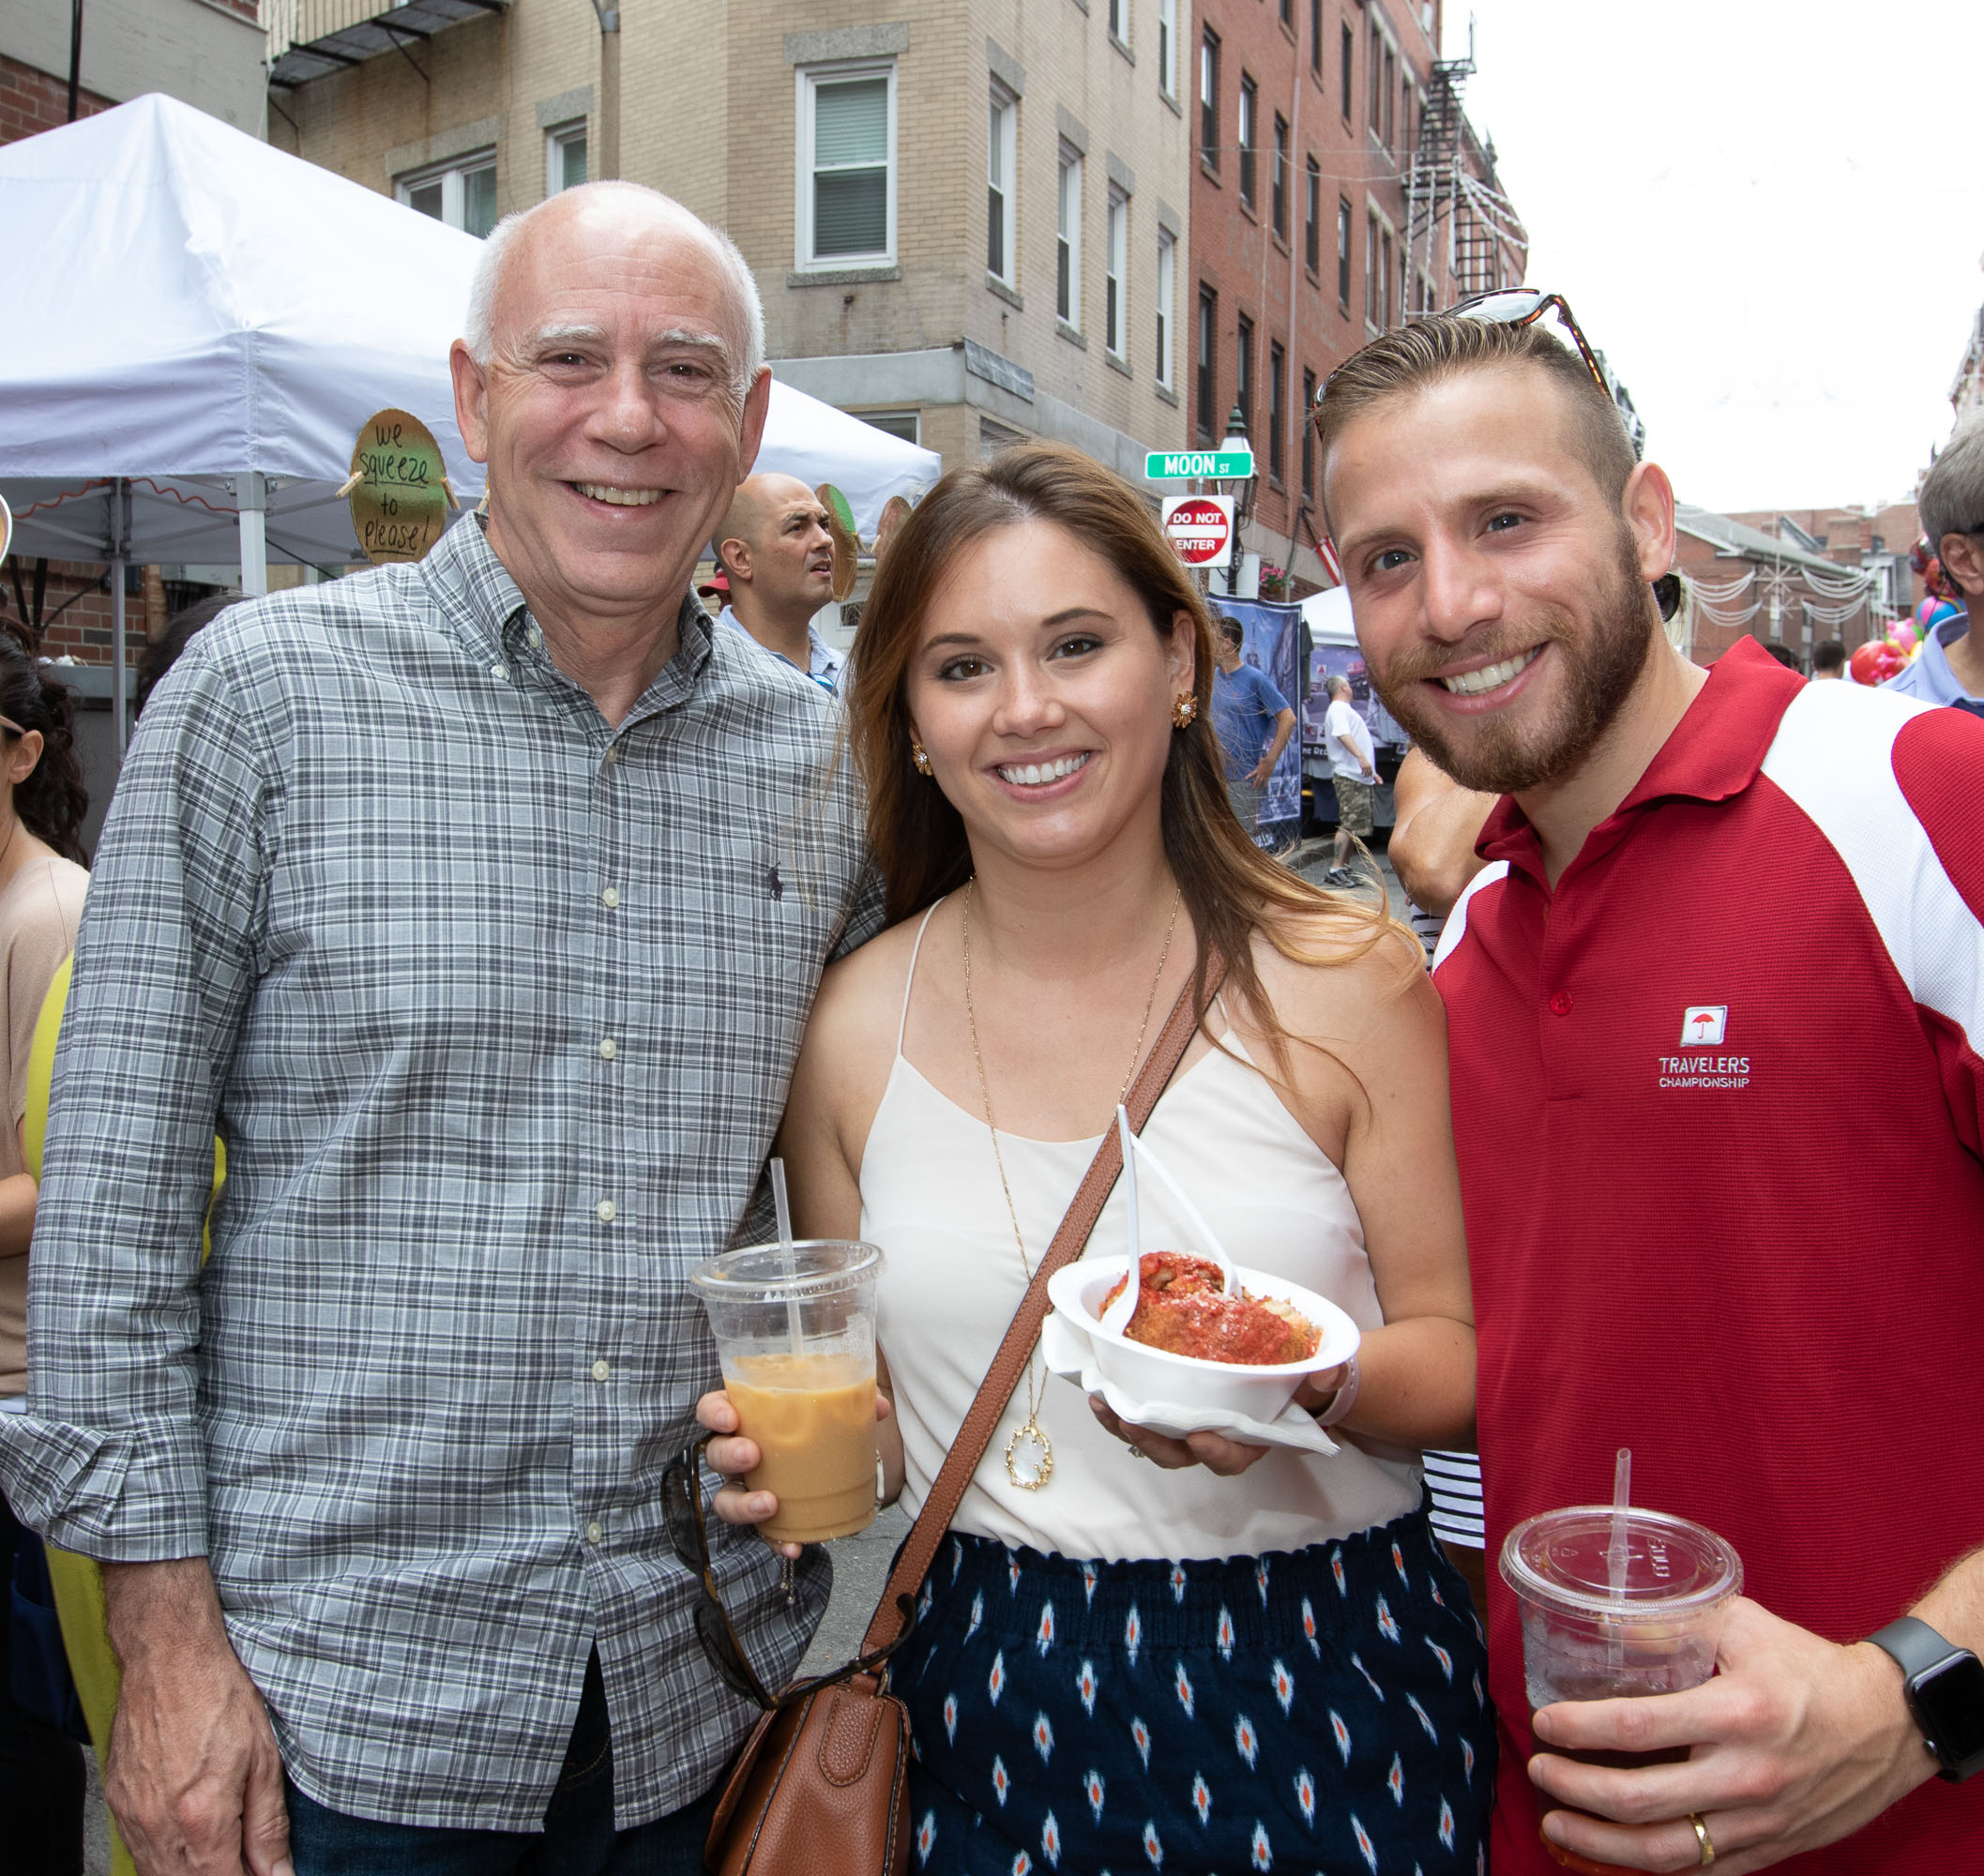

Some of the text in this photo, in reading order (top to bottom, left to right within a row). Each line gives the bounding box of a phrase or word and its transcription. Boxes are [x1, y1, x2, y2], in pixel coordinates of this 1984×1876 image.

[359, 452, 430, 487] squeeze
[1164, 455, 1230, 475] MOON ST
[381, 492, 398, 516] to
[1173, 512, 1222, 523] DO NOT
[1175, 539, 1216, 551] ENTER
[1658, 1056, 1750, 1074] TRAVELERS
[1658, 1077, 1750, 1088] CHAMPIONSHIP
